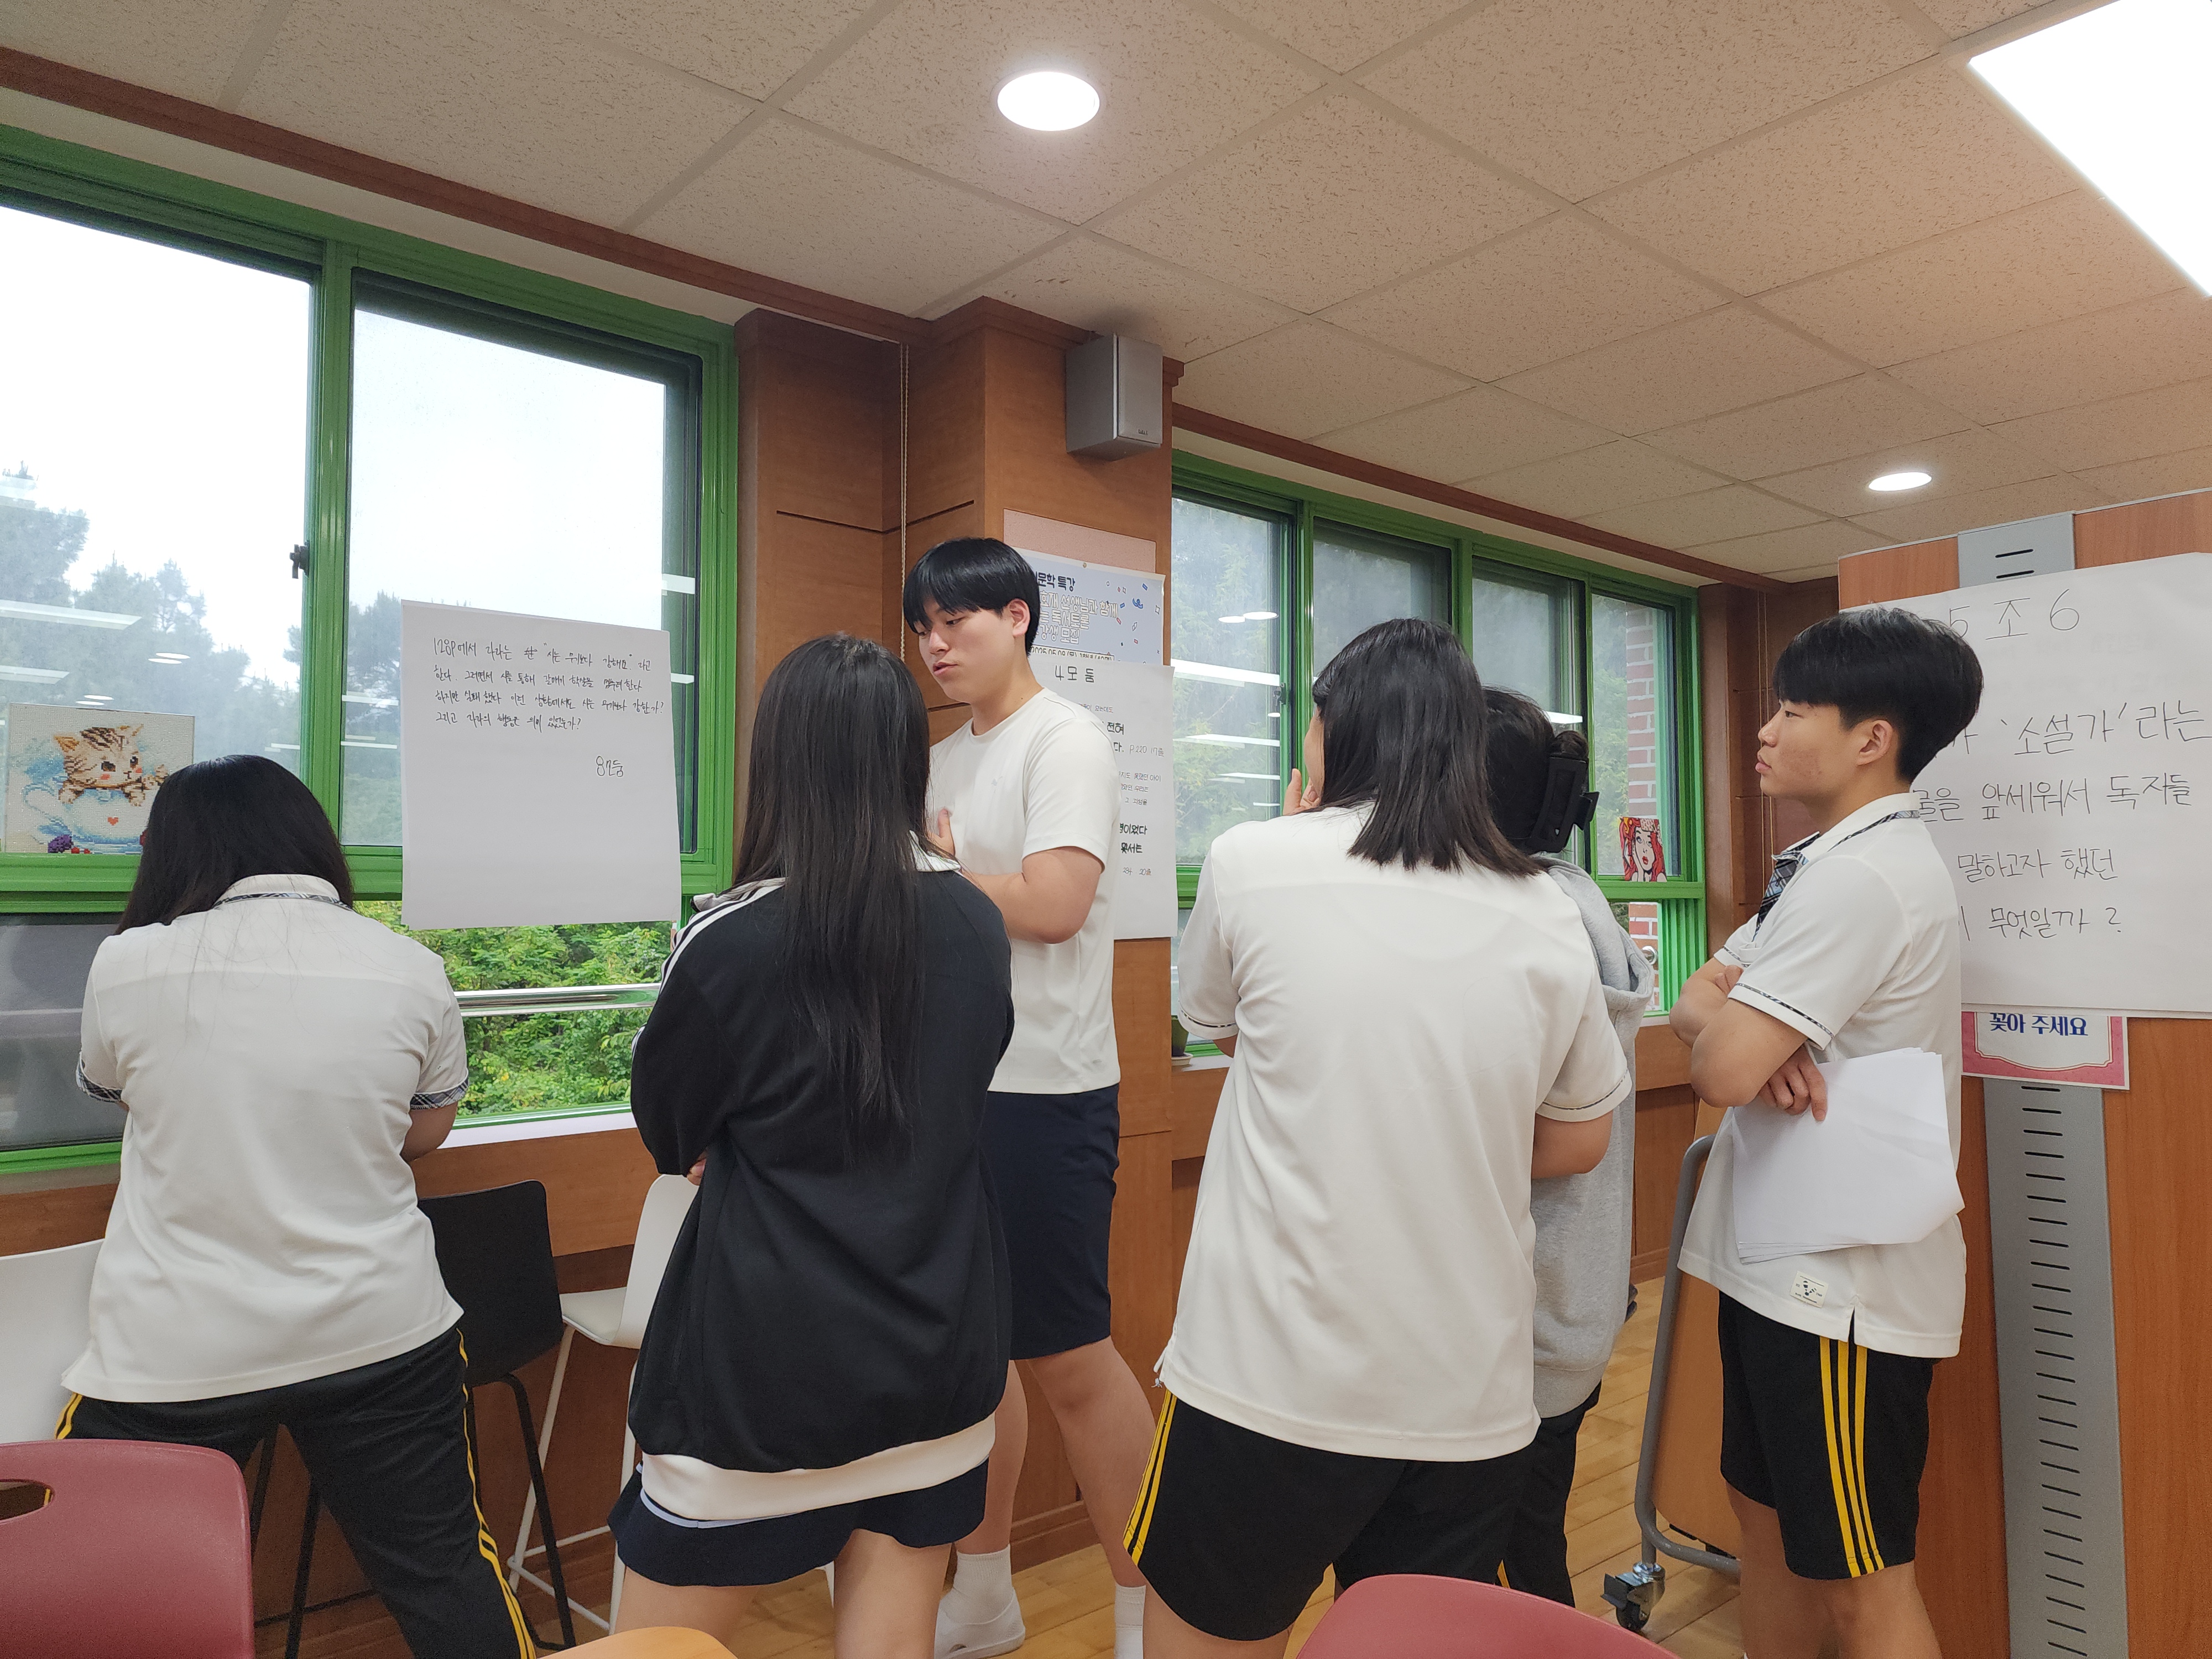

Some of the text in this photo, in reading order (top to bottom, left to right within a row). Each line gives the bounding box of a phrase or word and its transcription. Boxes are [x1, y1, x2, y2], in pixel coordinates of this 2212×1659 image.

[1035, 571, 1076, 592] 문학 특강
[1061, 594, 1098, 615] 선생님과
[1099, 600, 1118, 618] 함께
[1051, 609, 1089, 629] 독서토론
[1036, 624, 1079, 644] 강생 모집
[465, 670, 493, 684] 그러면서
[517, 672, 535, 686] 통해
[624, 679, 643, 692] 한다
[435, 690, 460, 705] 하지만
[510, 692, 526, 707] 이런
[582, 697, 596, 710] 시는
[436, 711, 458, 725] 그리고
[1981, 777, 2091, 821] 앞세워서
[2106, 772, 2193, 810] 독자들
[1957, 847, 2119, 883] 말하고자 했던
[2031, 1015, 2088, 1036] 주세요
